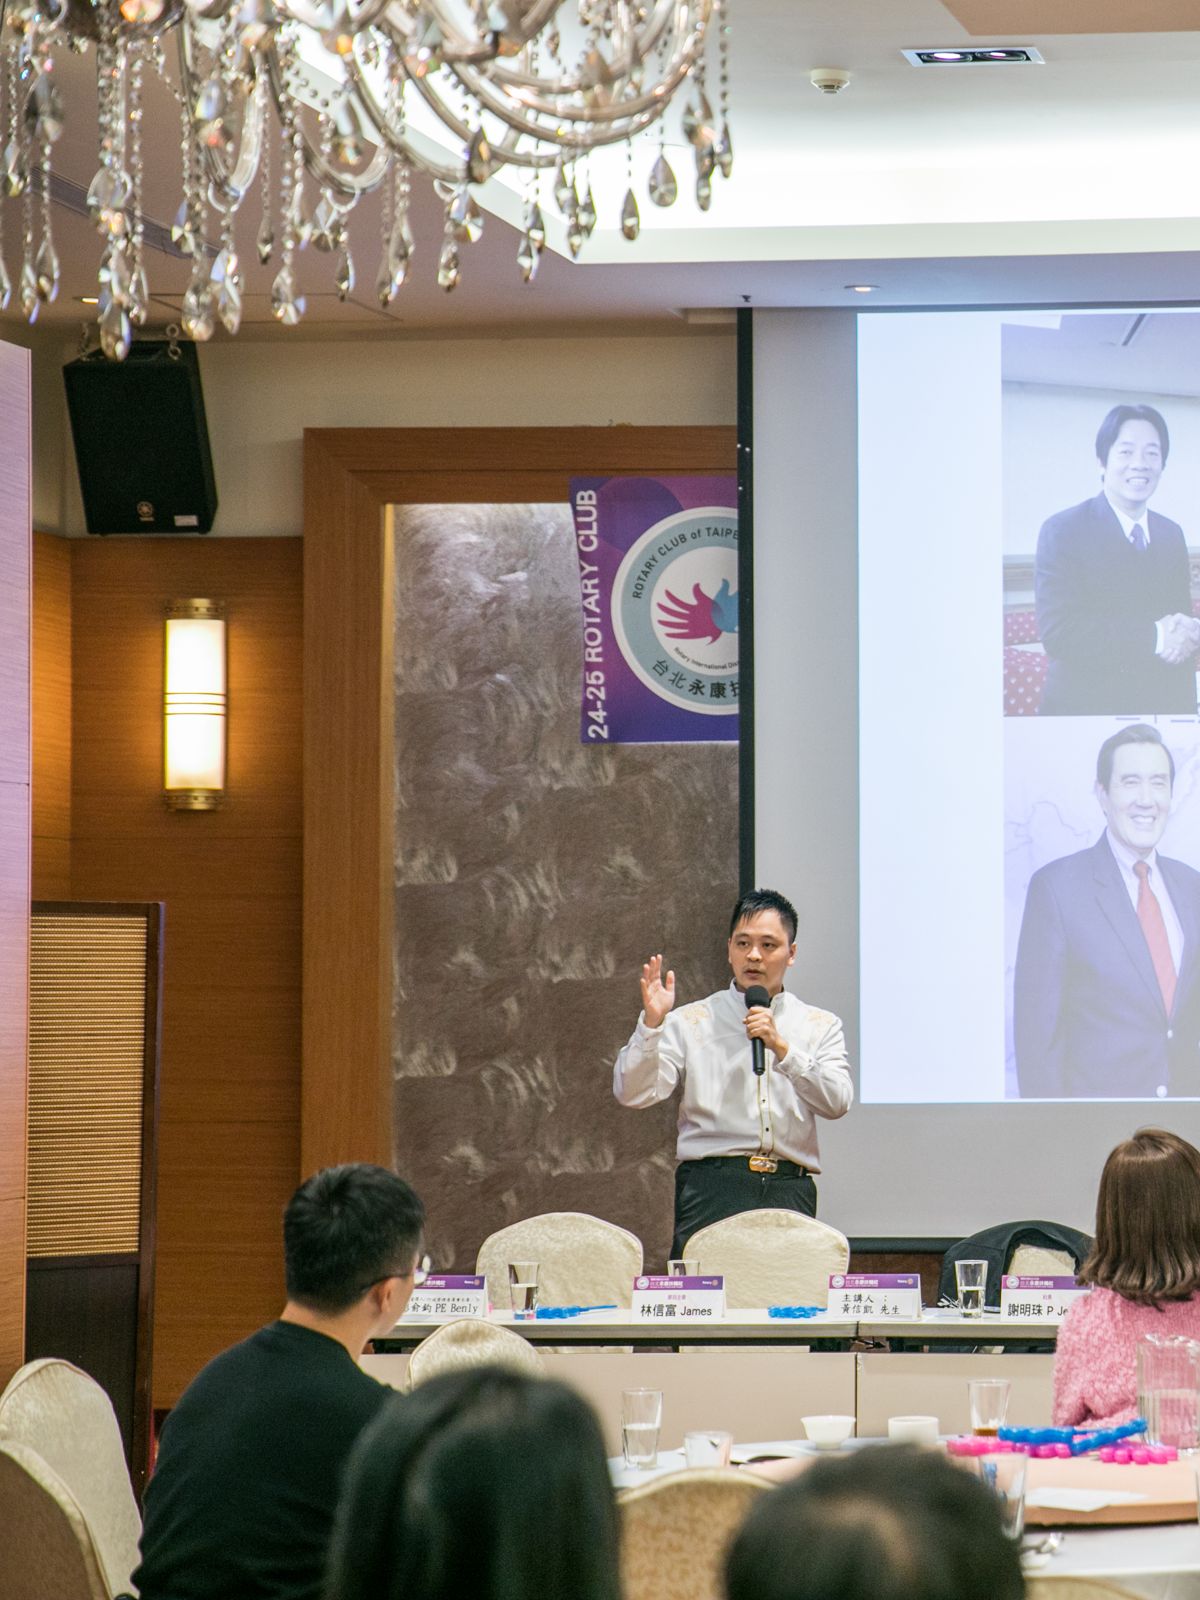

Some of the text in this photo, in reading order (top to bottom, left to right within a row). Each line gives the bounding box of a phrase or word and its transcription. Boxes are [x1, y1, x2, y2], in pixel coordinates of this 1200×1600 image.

[632, 554, 659, 599] ROTARY
[657, 533, 688, 556] CLUB
[690, 529, 702, 540] of
[576, 490, 609, 739] 24-25 ROTARY CLUB
[435, 1303, 447, 1313] PE
[450, 1303, 478, 1314] Benly
[640, 1304, 712, 1317] 林信富 James
[1007, 1303, 1043, 1317] 謝明珠
[1047, 1306, 1054, 1316] P
